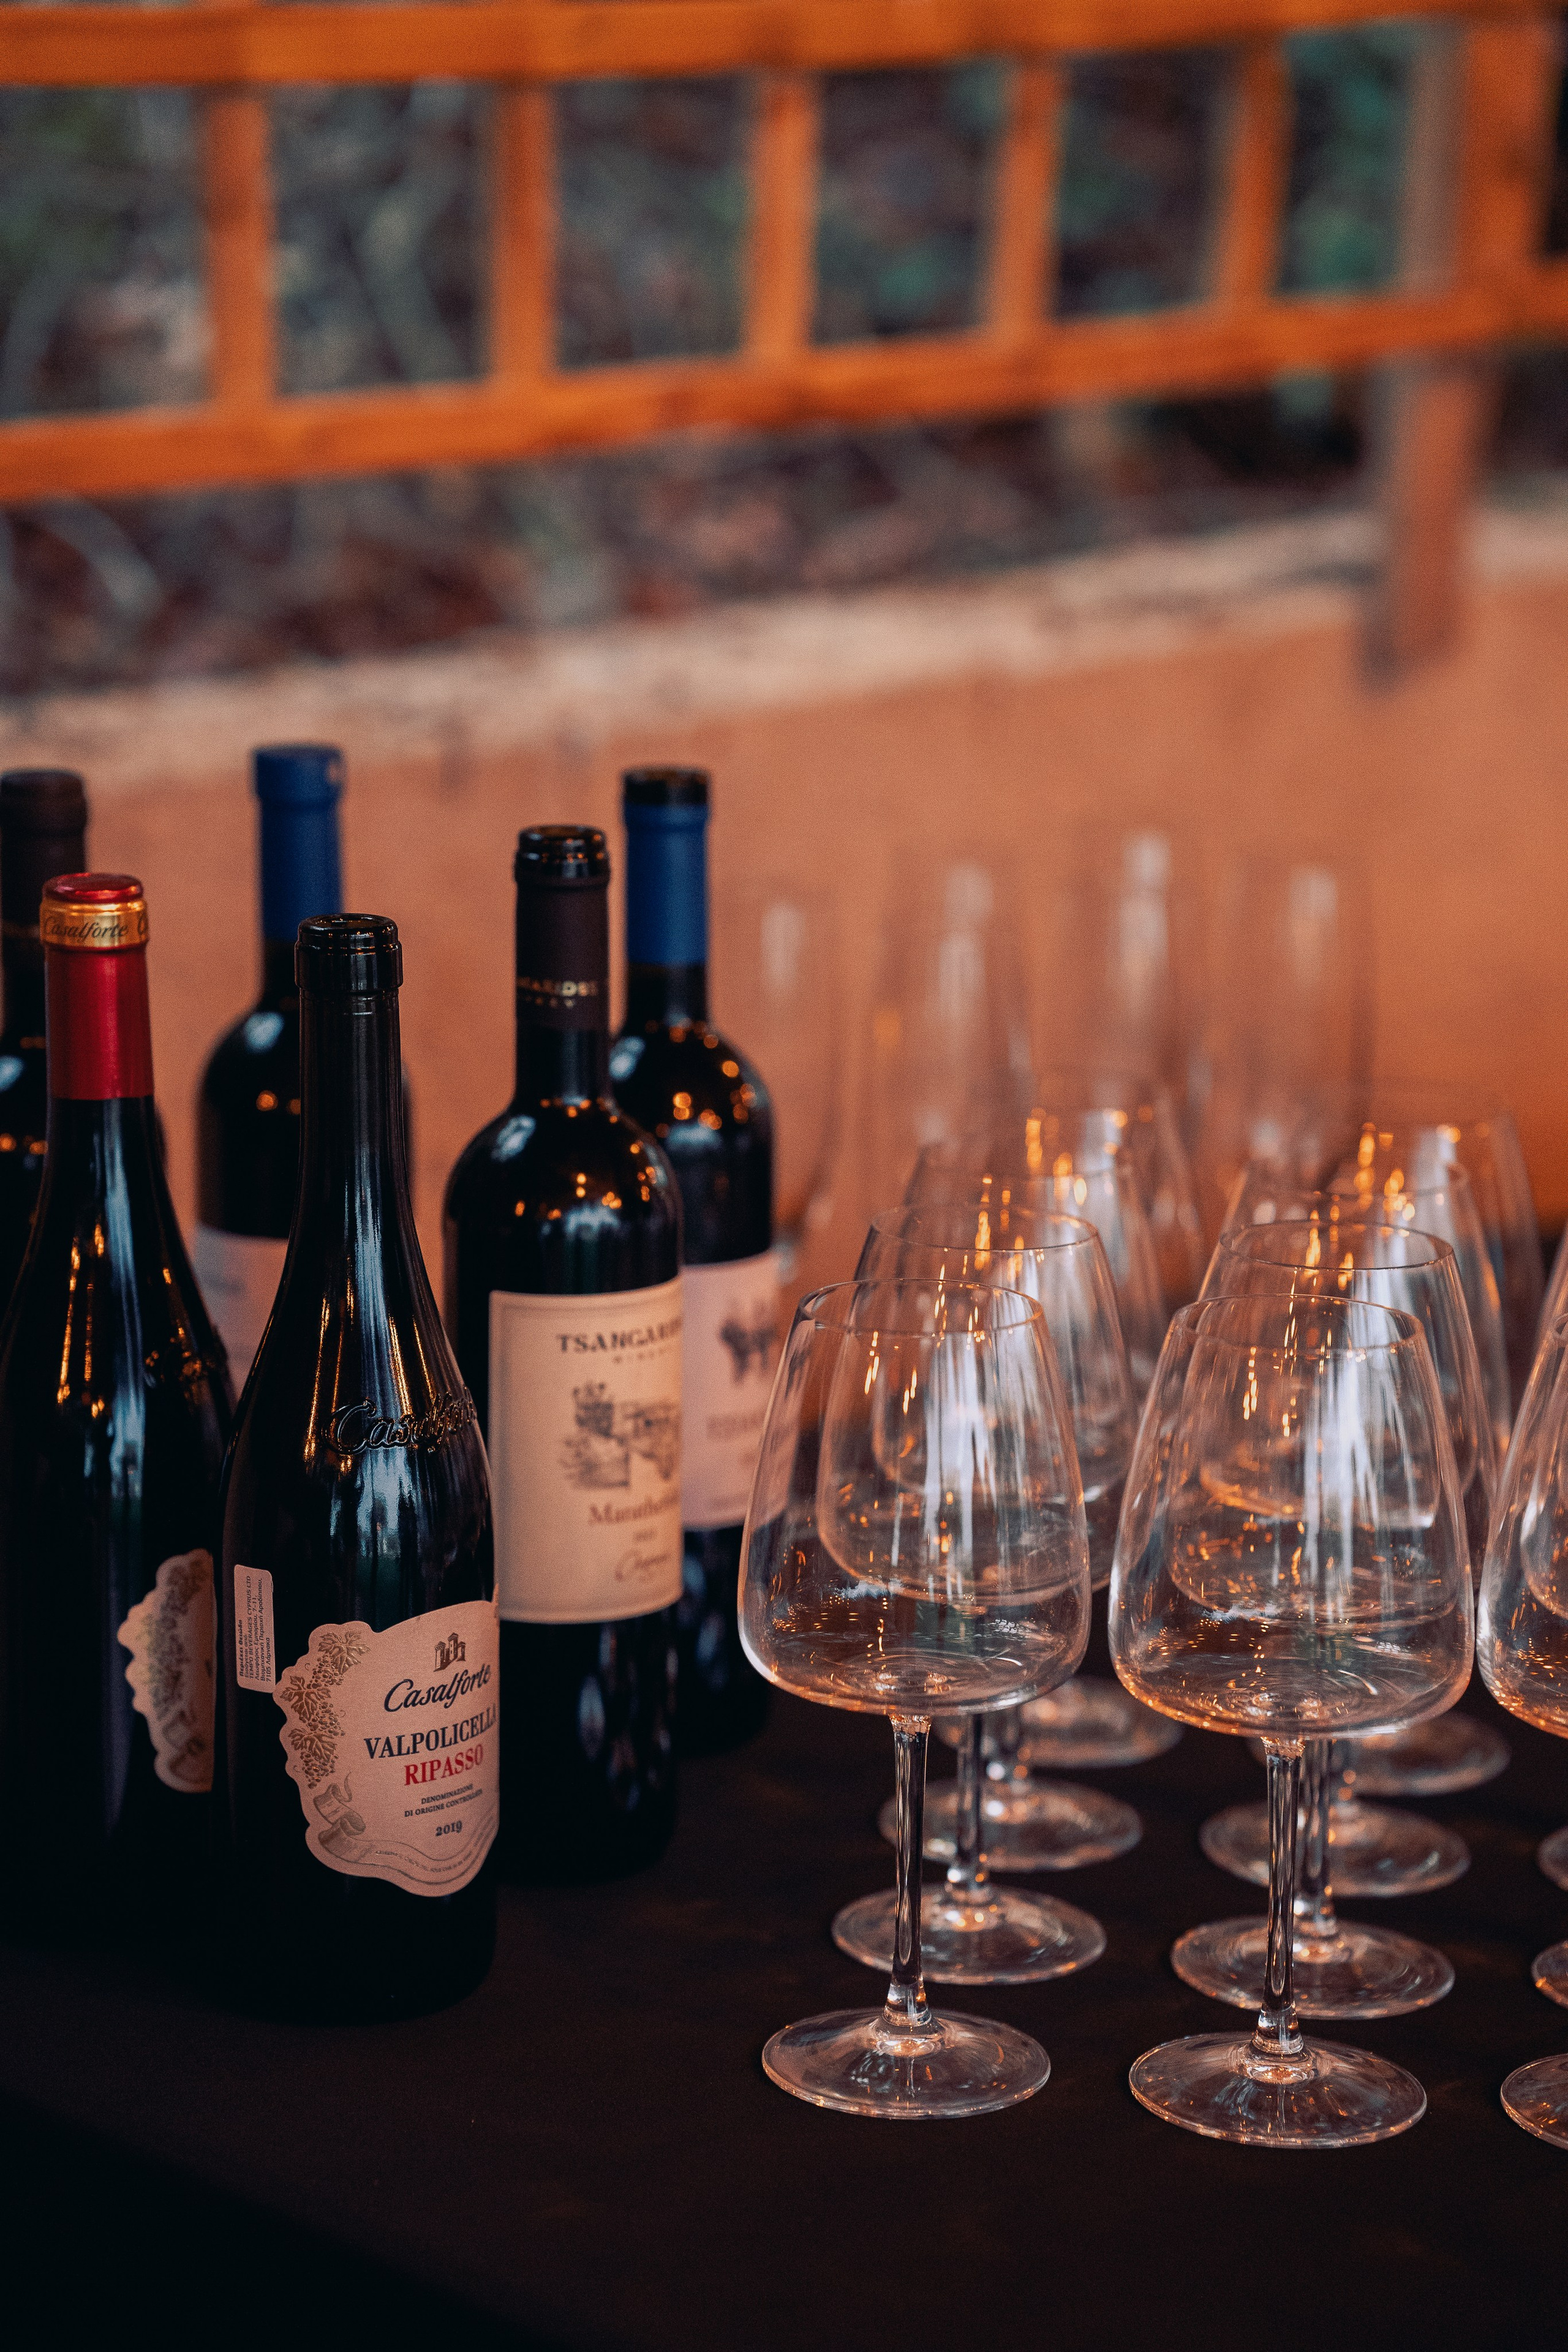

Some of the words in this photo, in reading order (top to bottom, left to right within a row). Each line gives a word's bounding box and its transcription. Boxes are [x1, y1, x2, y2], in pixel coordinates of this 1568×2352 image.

[43, 916, 129, 944] Casalforte
[383, 1663, 491, 1712] Casalforte
[404, 1744, 484, 1786] RIPASSO
[415, 1803, 445, 1815] ORIGINE
[435, 1820, 462, 1836] 2019
